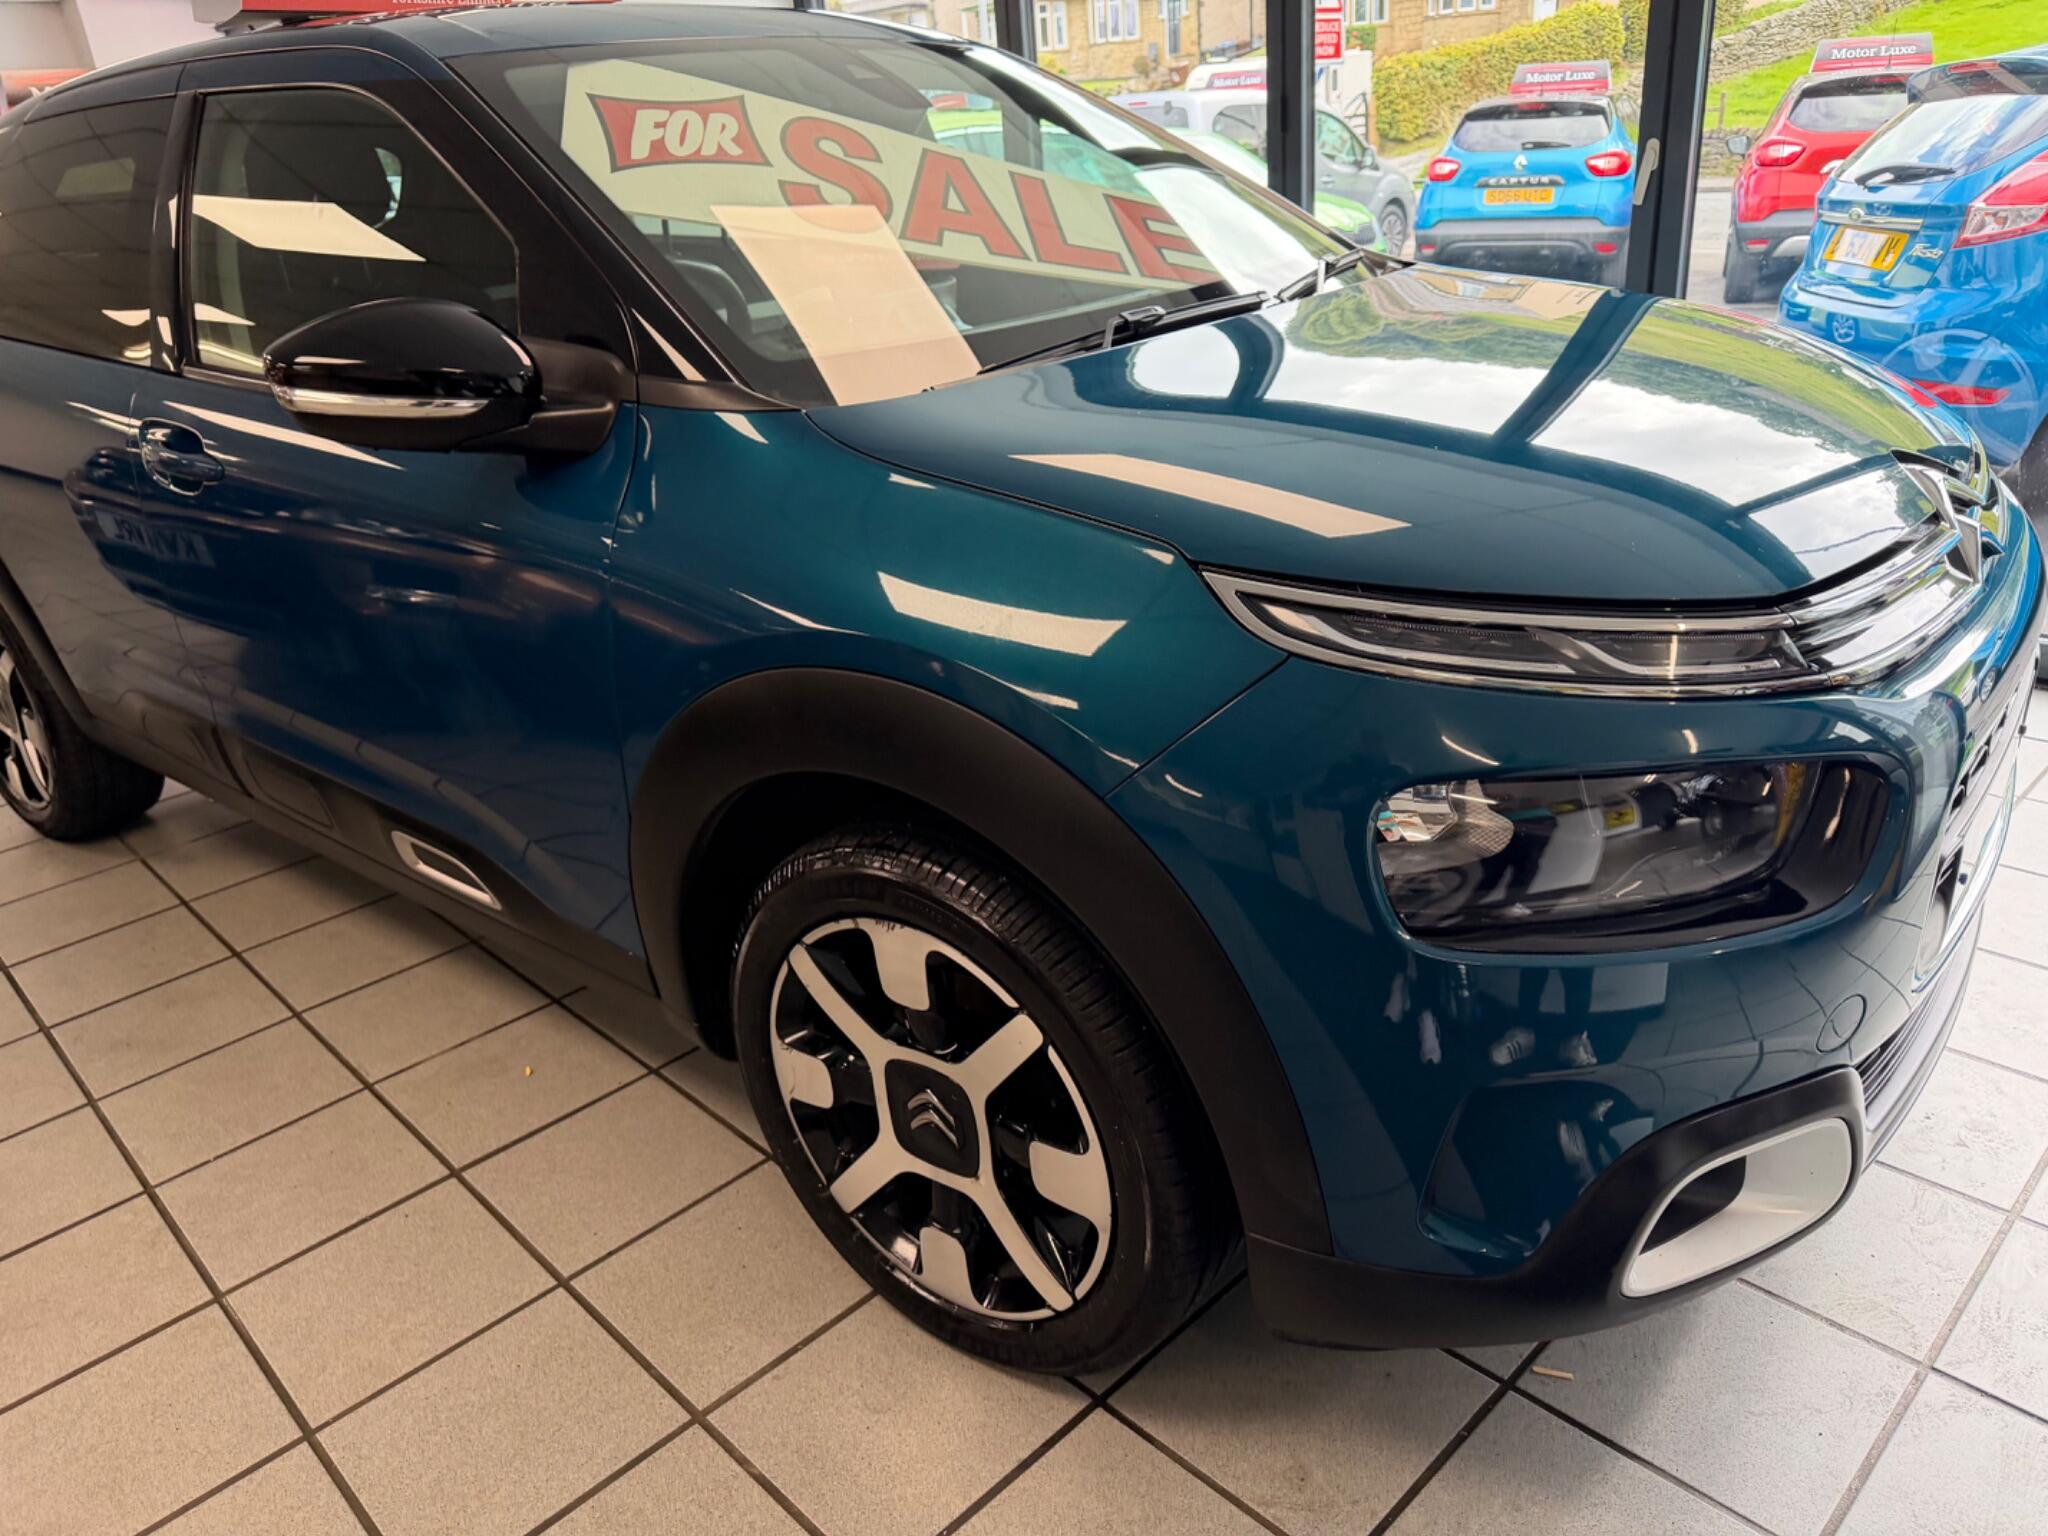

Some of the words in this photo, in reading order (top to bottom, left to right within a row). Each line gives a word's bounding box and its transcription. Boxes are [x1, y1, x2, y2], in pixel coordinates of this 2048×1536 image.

[1830, 47, 1877, 59] Motor
[1880, 45, 1917, 56] Luxe
[1525, 72, 1563, 83] Motor
[1565, 71, 1596, 81] Luxe
[1488, 176, 1550, 186] CAPTUR
[630, 108, 746, 160] FOR
[778, 116, 1226, 284] SALE
